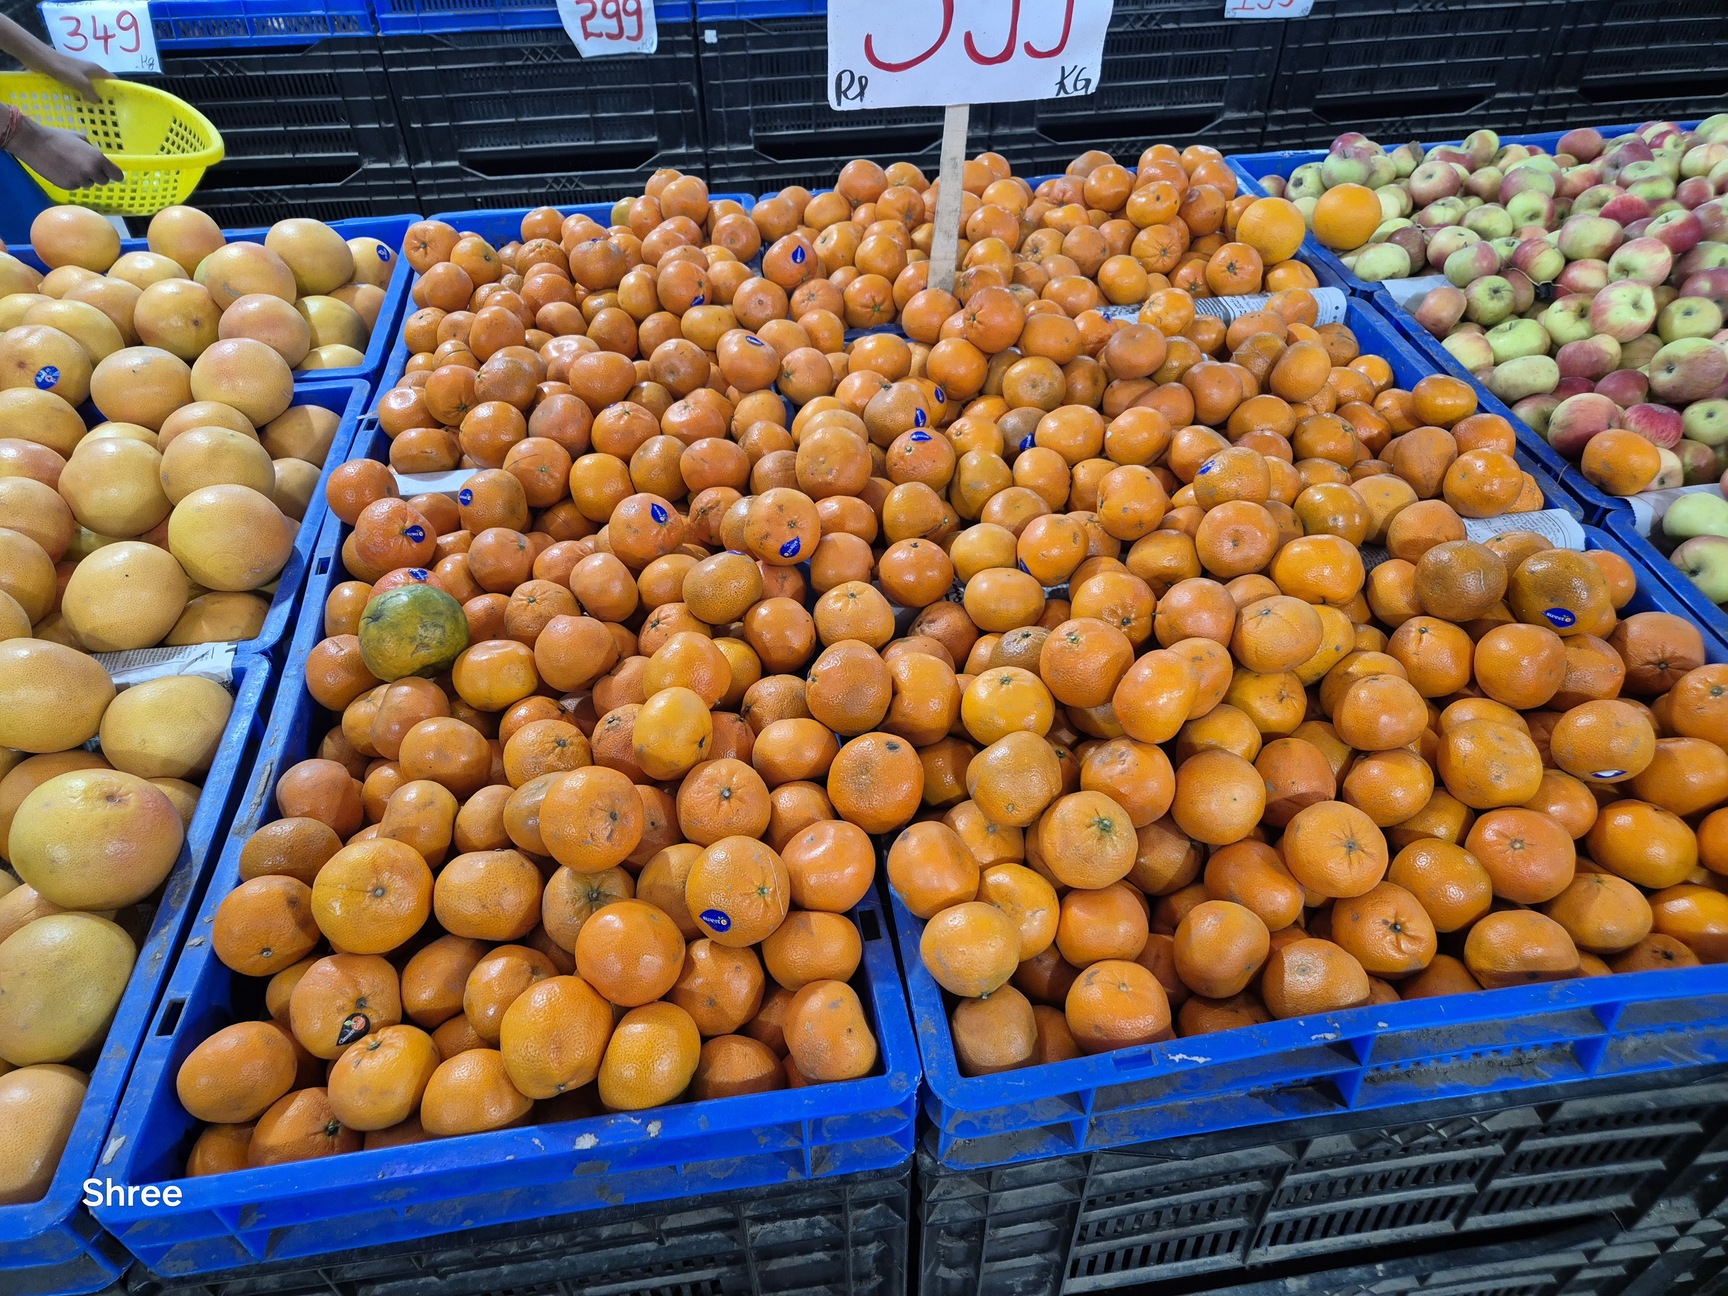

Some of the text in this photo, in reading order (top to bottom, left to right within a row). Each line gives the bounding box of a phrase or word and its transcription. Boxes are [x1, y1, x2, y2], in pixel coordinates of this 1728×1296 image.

[59, 10, 141, 55] 349
[575, 0, 644, 42] 299
[1055, 64, 1092, 97] KG
